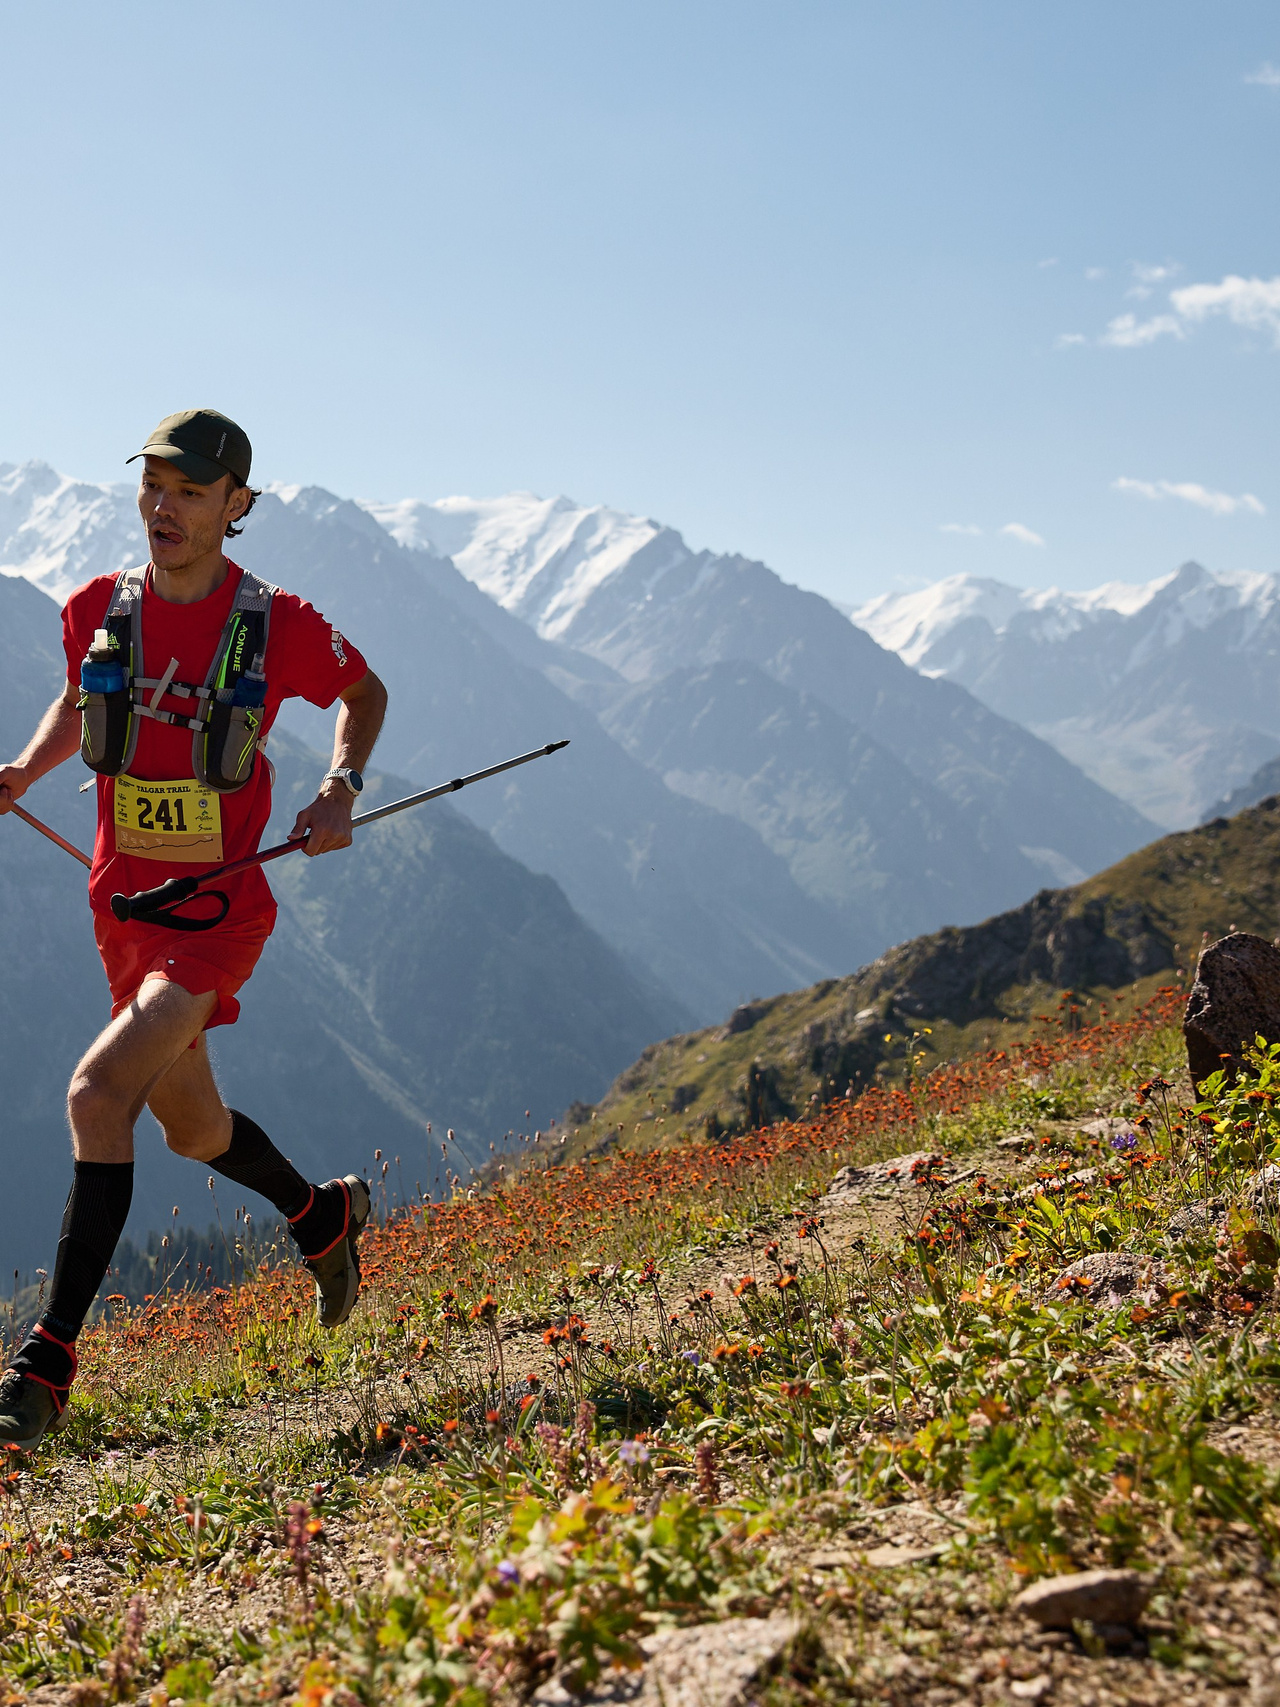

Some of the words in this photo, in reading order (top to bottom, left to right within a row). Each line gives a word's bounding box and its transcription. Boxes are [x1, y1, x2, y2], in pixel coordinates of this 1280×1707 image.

[233, 625, 248, 672] AONIJIE
[136, 785, 165, 793] TALGAR
[136, 797, 187, 831] 241
